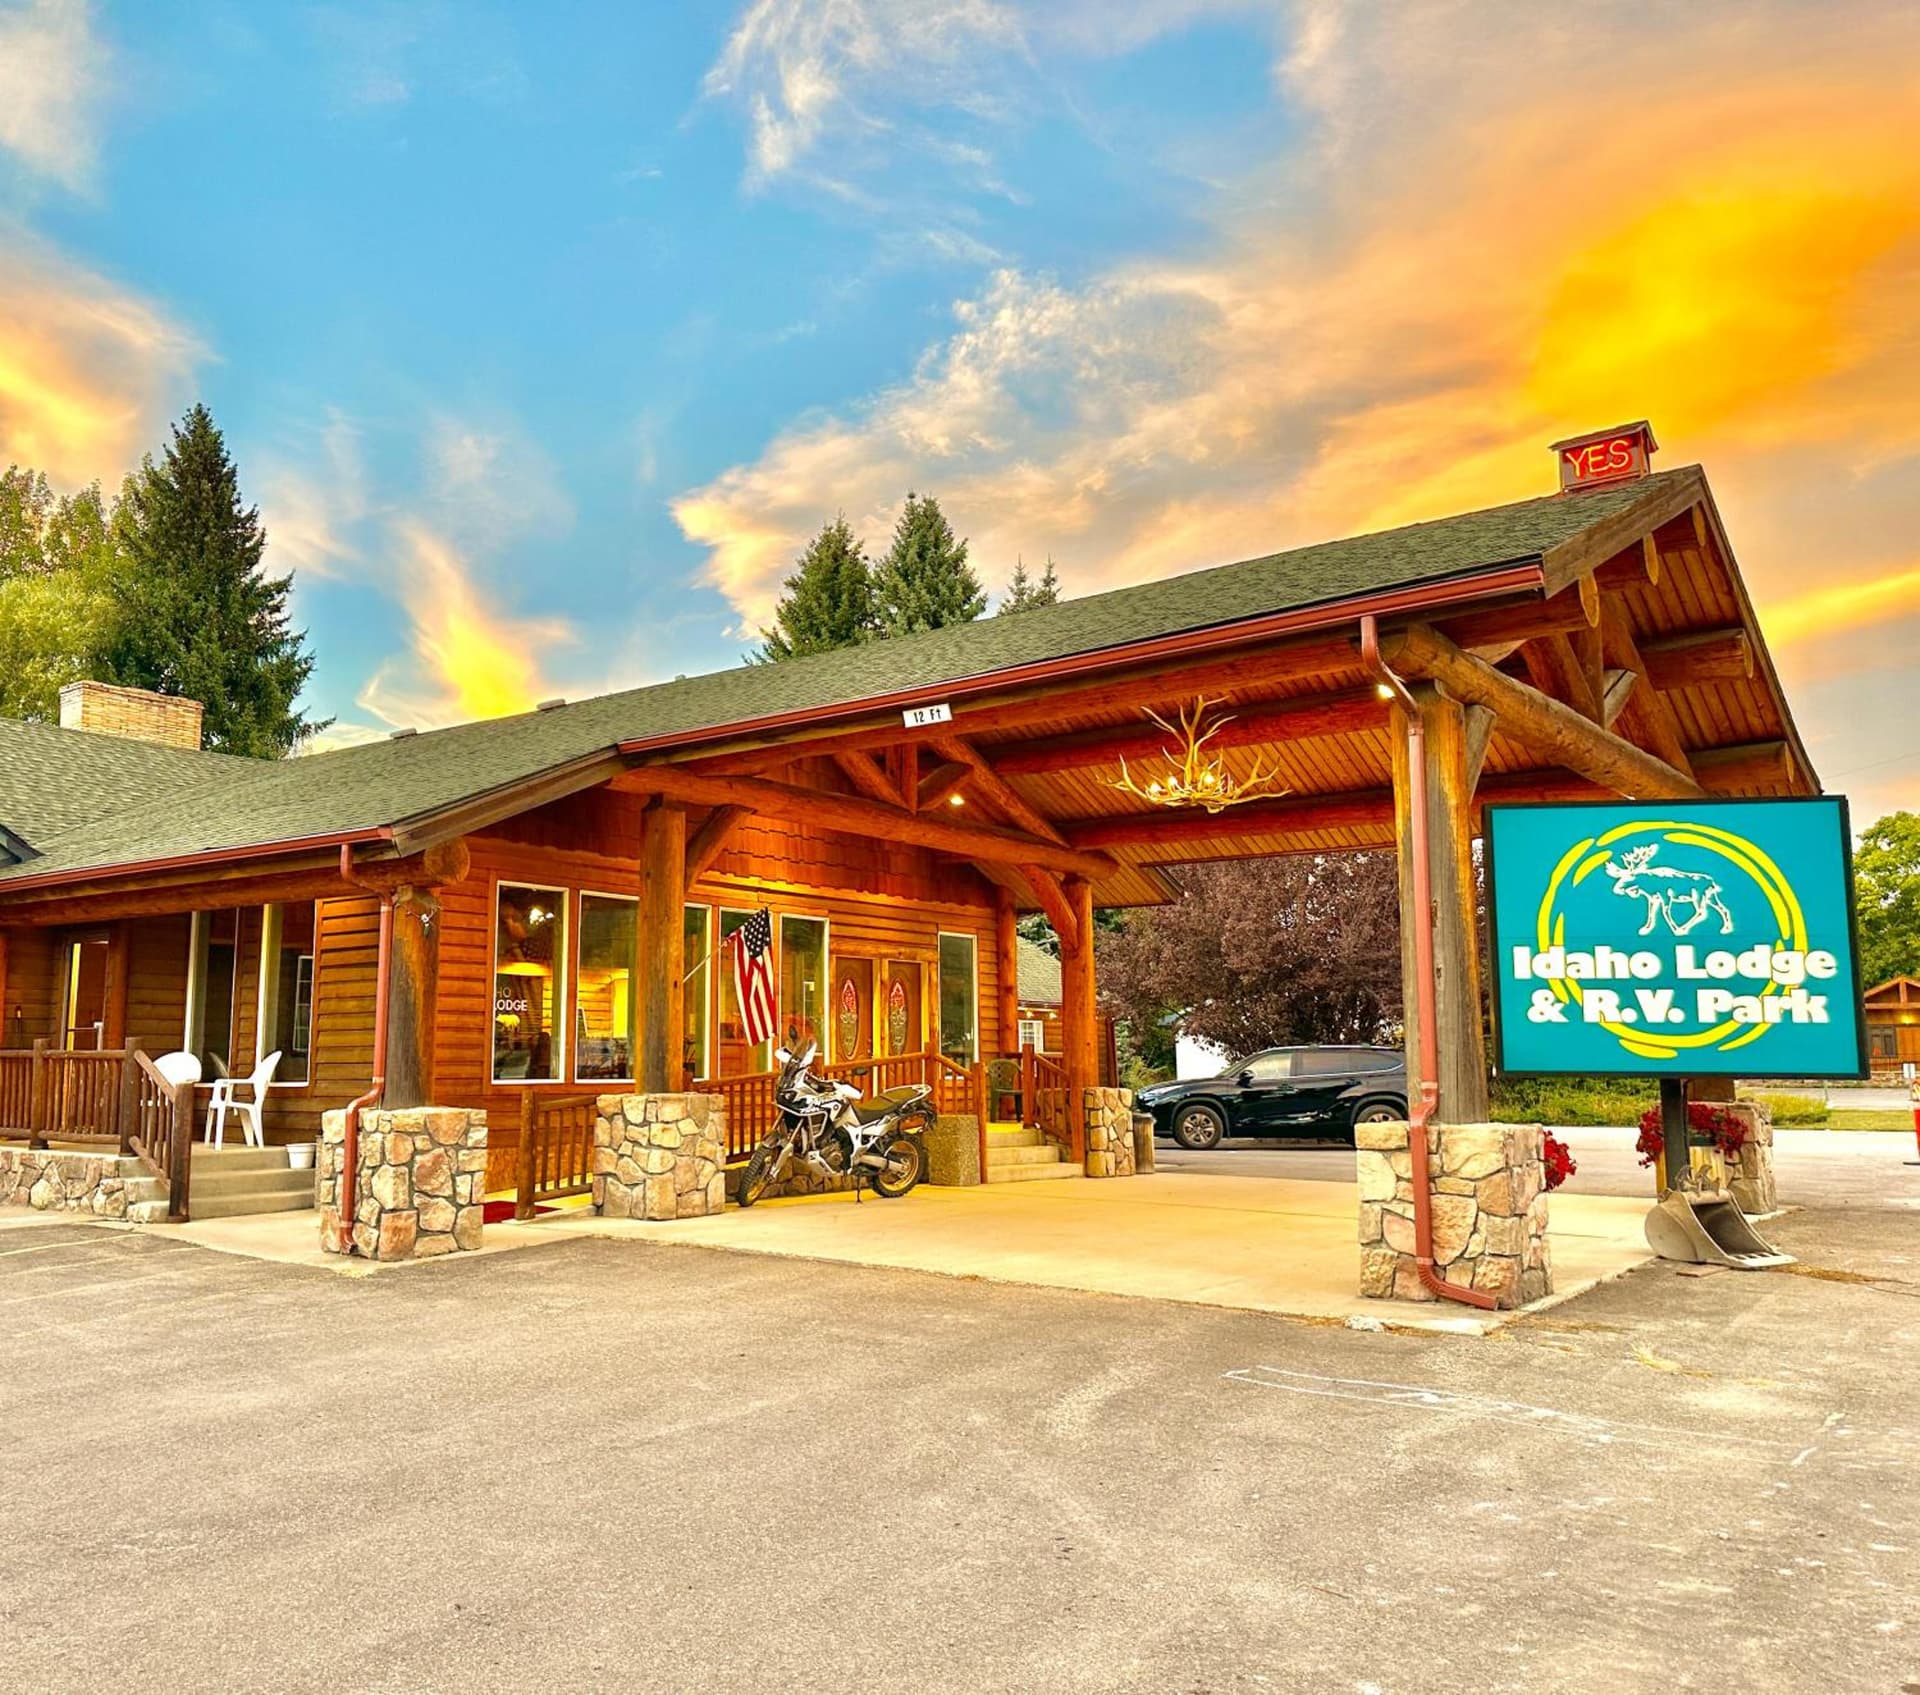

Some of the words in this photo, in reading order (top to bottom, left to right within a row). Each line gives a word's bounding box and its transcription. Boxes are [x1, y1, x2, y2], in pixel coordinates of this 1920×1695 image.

[1565, 439, 1629, 478] YES
[913, 710, 925, 723] 12
[930, 708, 941, 720] Ft
[1512, 945, 1662, 980] Idaho
[1675, 944, 1838, 986] Lodge
[494, 999, 528, 1011] ODGE
[1526, 989, 1569, 1024] &
[1582, 988, 1686, 1024] R.V.
[1696, 987, 1829, 1024] Park
